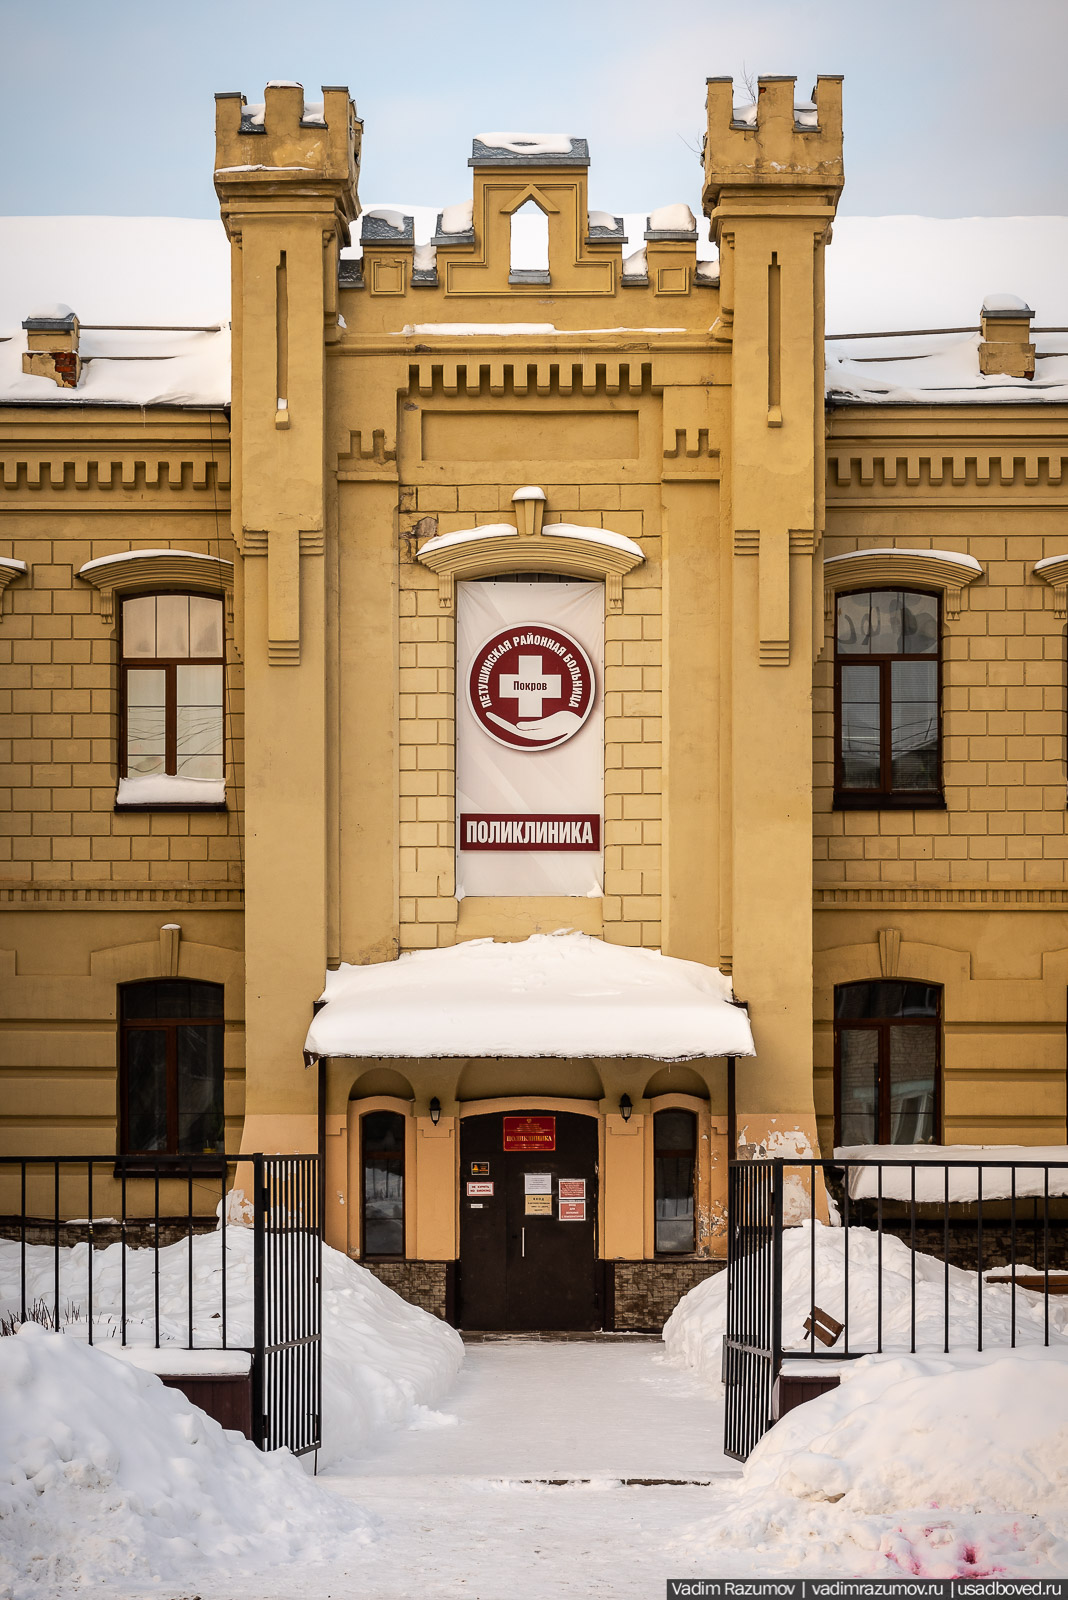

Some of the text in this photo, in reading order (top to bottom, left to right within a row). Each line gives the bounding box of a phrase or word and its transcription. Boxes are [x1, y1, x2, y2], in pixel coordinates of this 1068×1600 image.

[477, 632, 583, 709] ПЕТУШИНСКАЯ РАЙОННАЯ БОЛЬНИЦА
[513, 680, 548, 692] Покров
[466, 820, 594, 844] ПОЛИКЛИНИКА
